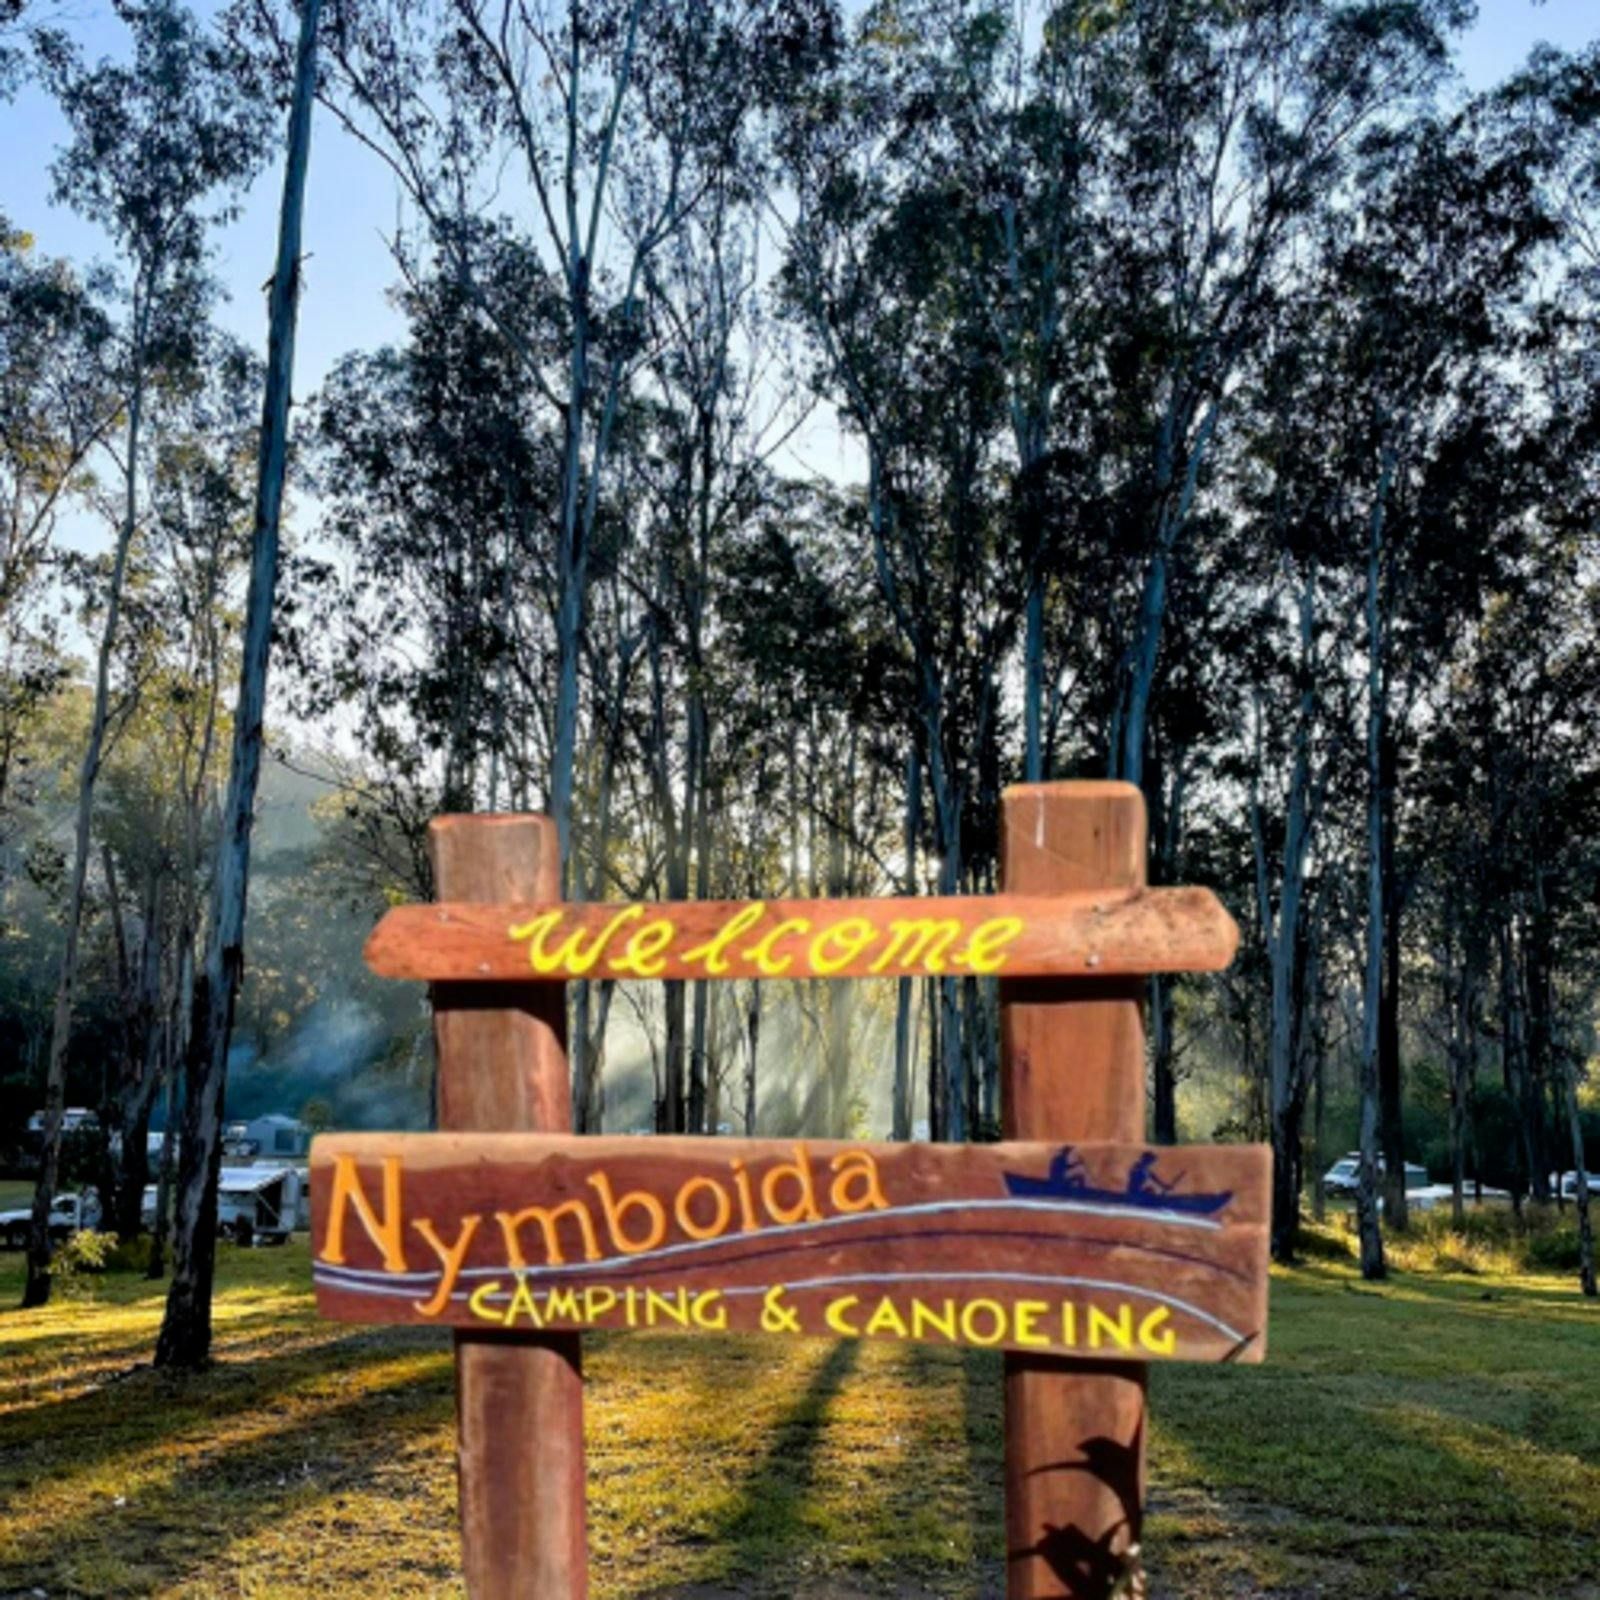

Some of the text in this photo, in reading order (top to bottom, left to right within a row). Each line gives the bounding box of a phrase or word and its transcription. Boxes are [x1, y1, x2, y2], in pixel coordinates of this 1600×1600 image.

[321, 1144, 888, 1316] Nymboida
[469, 1273, 1176, 1355] CAMPING & CANOEING
